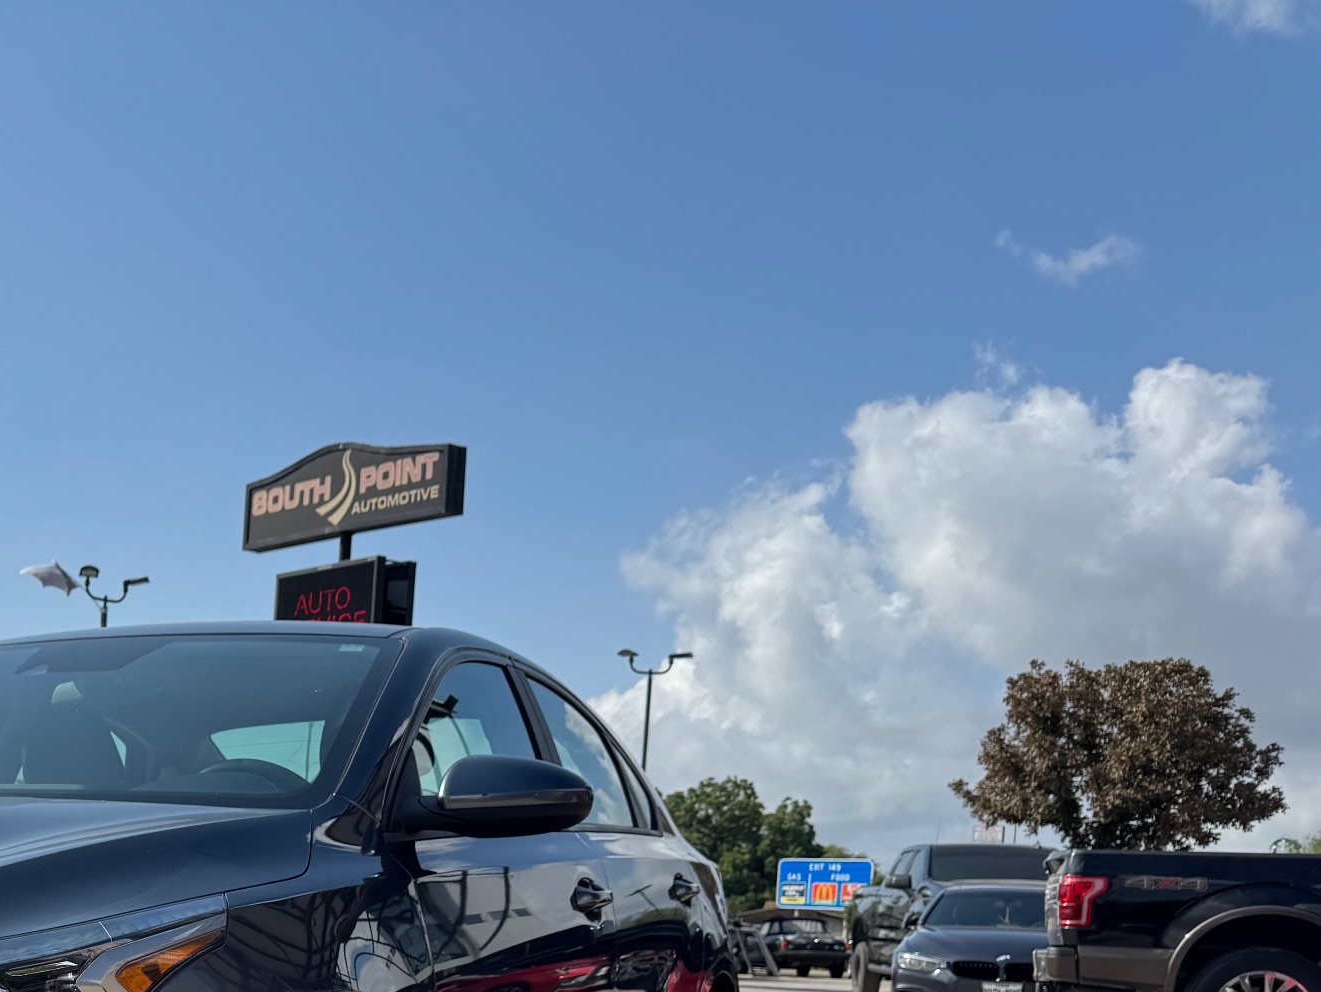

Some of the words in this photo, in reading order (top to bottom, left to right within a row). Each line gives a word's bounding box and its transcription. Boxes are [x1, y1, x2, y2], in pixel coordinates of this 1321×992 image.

[252, 475, 331, 516] SOUTH
[359, 452, 440, 495] POINT
[351, 484, 440, 515] AUTOMOTIVE
[294, 586, 351, 617] AUTO
[787, 873, 801, 881] GAS
[830, 873, 850, 882] FOOD
